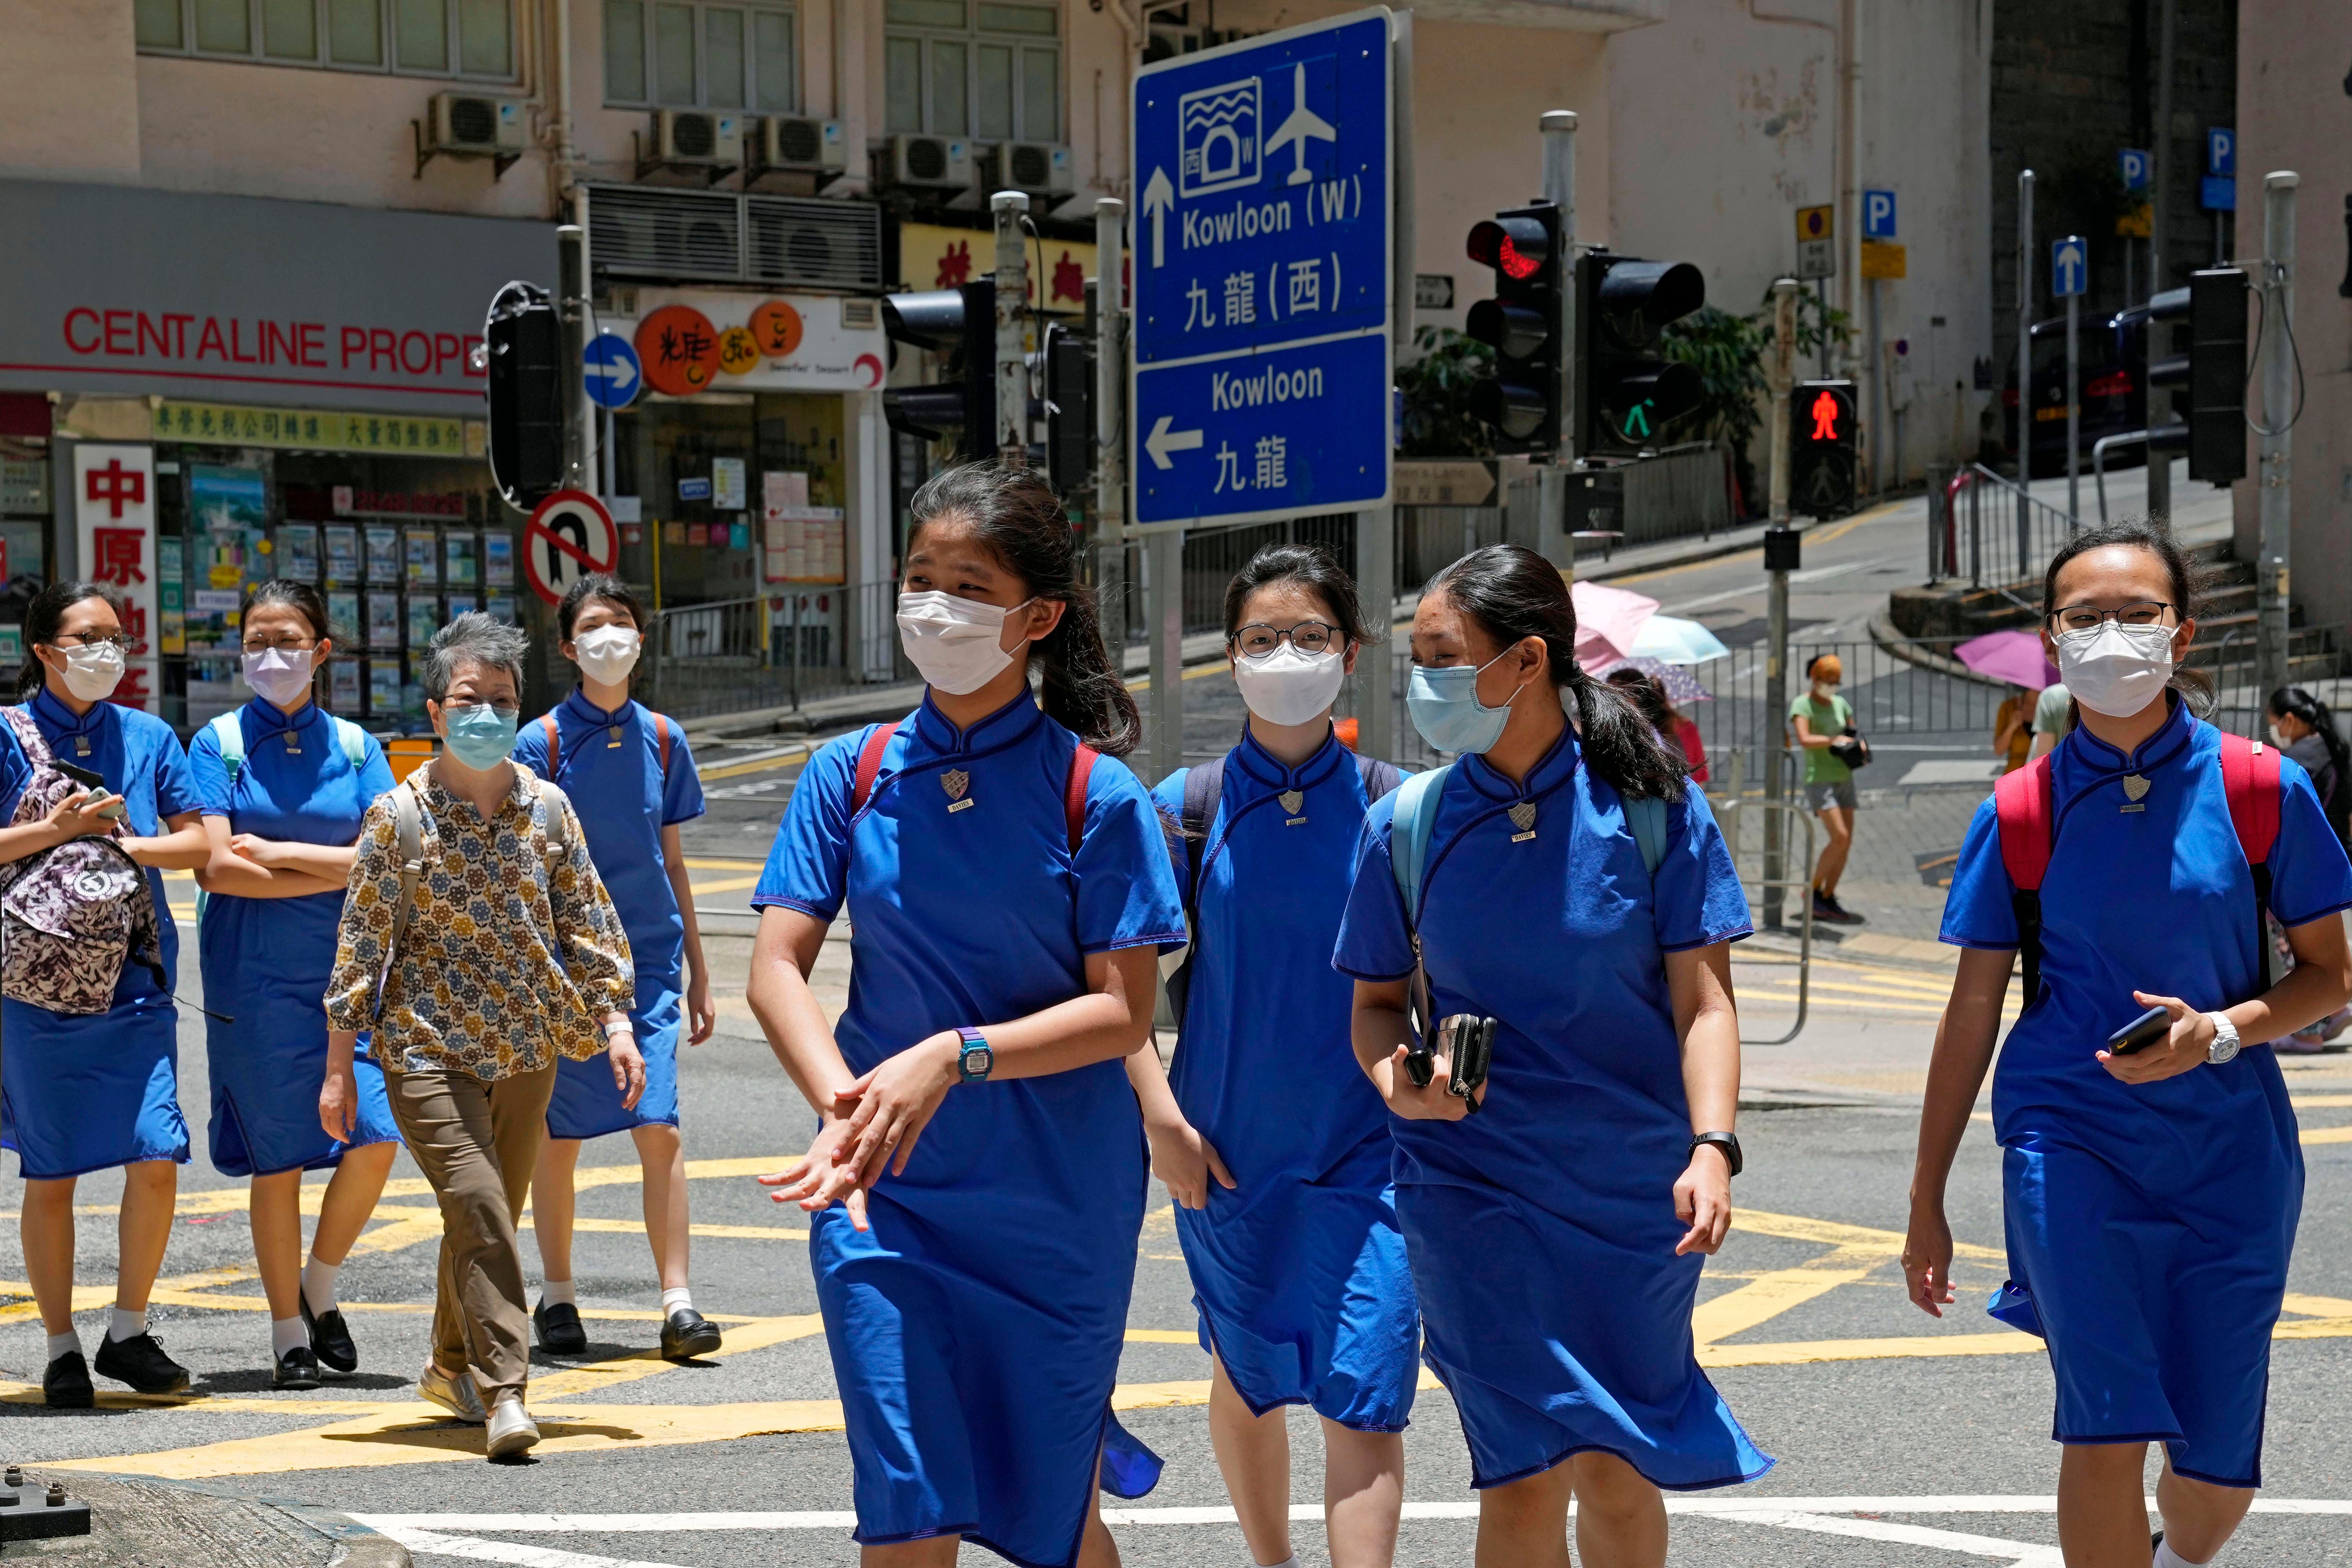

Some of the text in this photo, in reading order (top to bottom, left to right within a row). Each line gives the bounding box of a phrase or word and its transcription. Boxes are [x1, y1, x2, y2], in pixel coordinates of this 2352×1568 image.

[1241, 136, 1254, 163] W
[2214, 134, 2230, 169] P
[2124, 155, 2141, 188] P
[1183, 174, 1361, 250] Kowloon (W)
[1869, 194, 1891, 233] P
[63, 308, 327, 367] CENTALINE
[1212, 365, 1323, 412] Kowloon
[1214, 435, 1287, 494] 九龍
[952, 800, 970, 811] DAVIES
